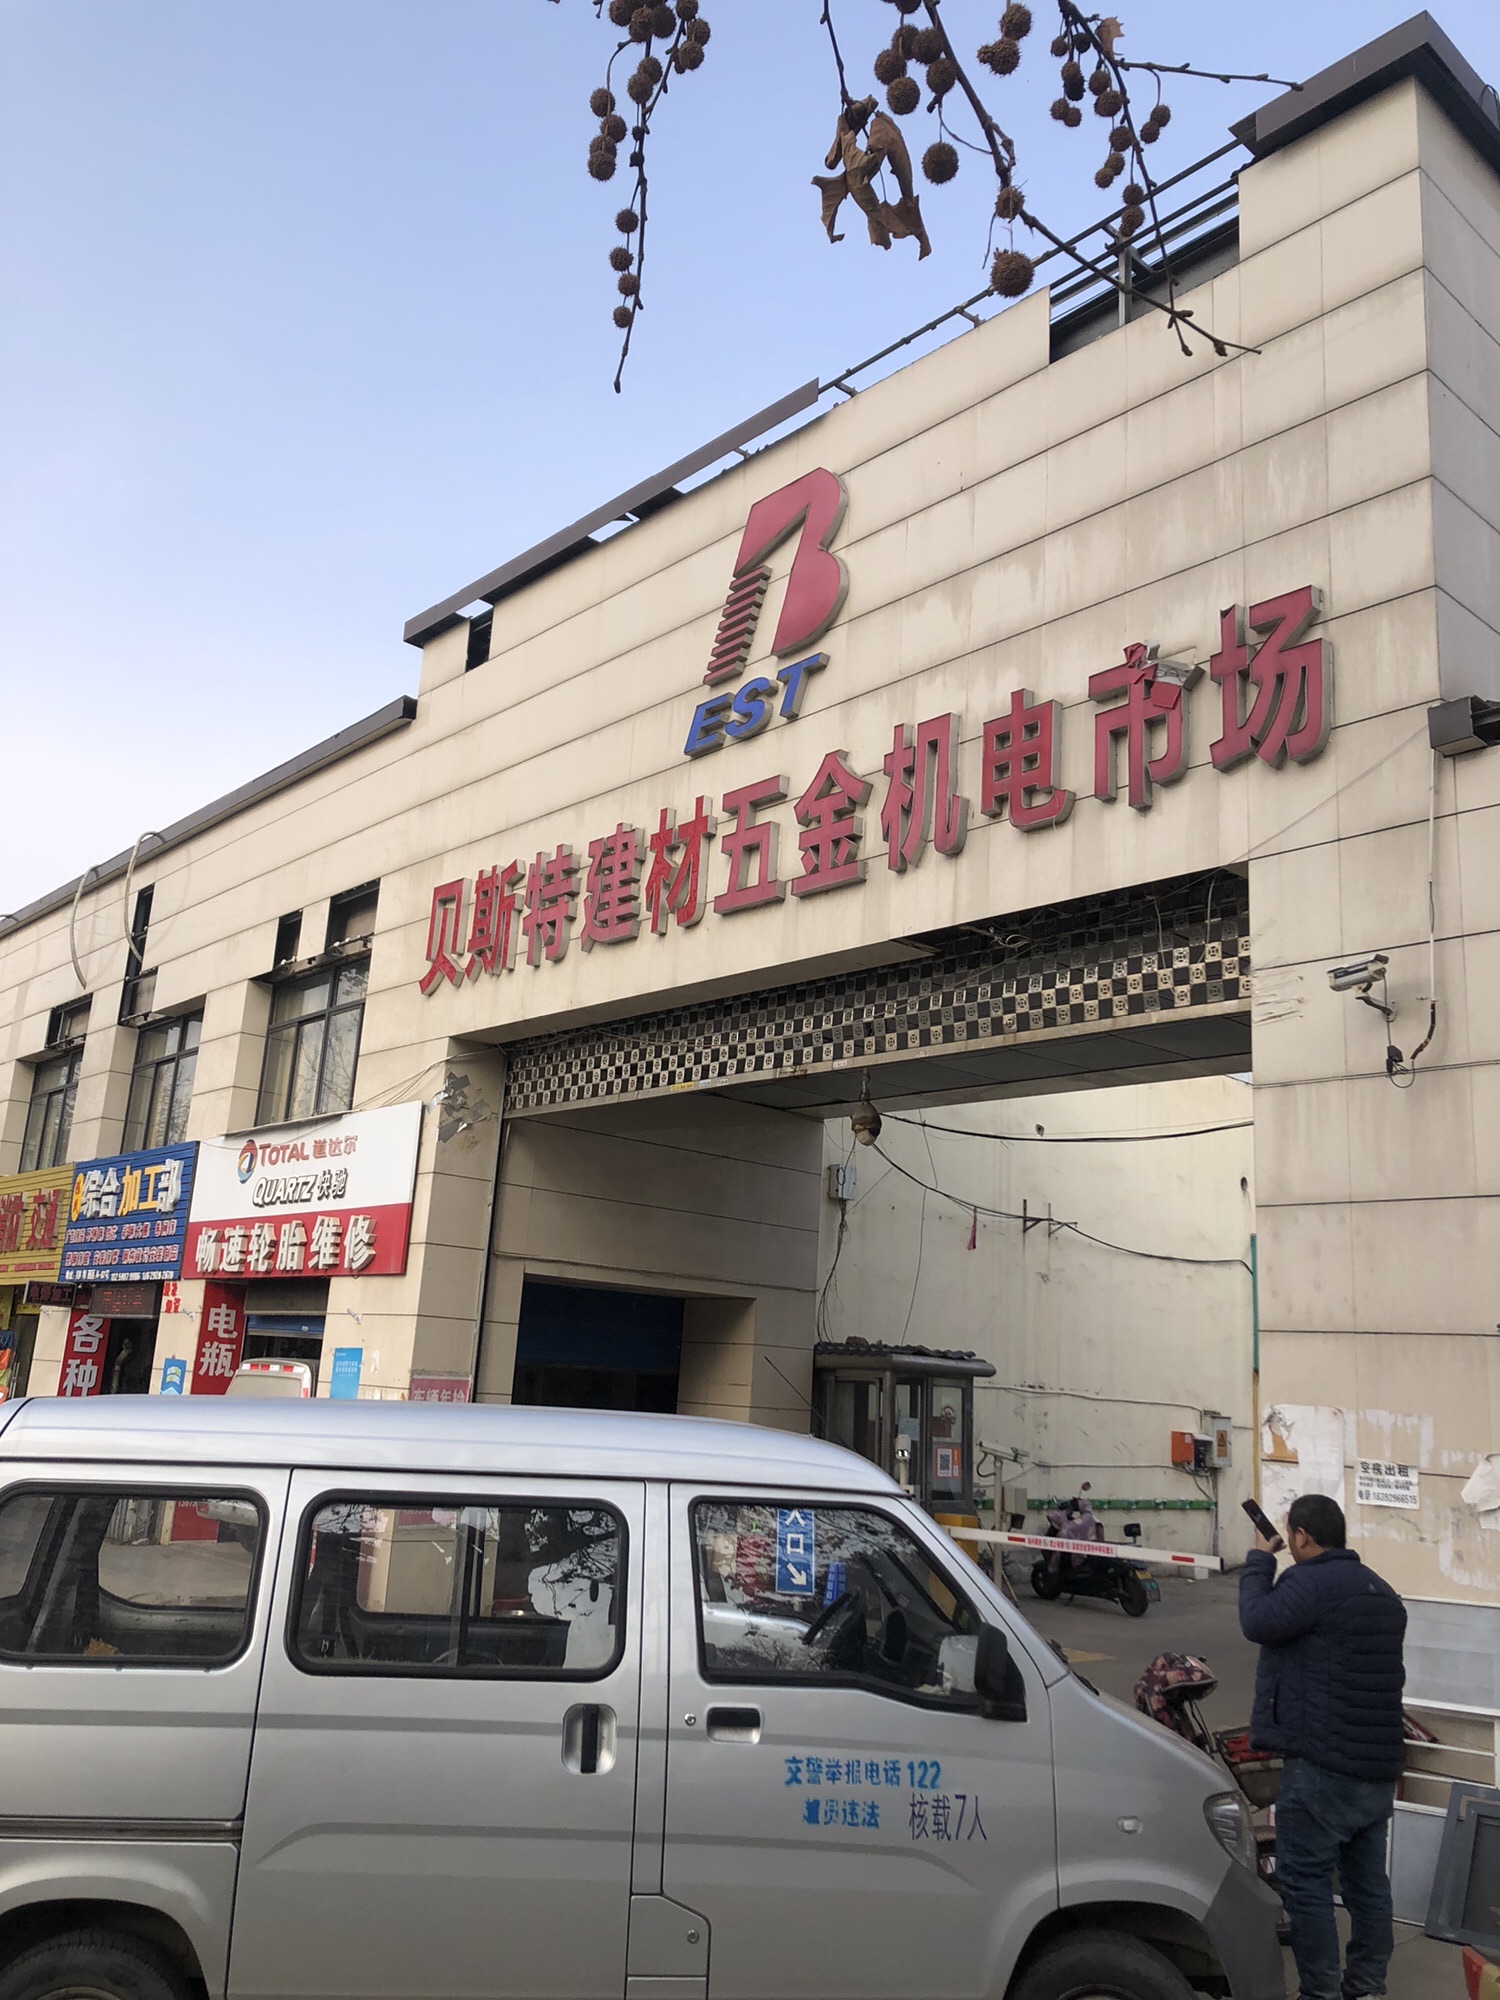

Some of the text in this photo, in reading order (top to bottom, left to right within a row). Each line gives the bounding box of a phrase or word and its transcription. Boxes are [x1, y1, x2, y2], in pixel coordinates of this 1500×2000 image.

[683, 652, 830, 758] EST
[419, 585, 1333, 996] 贝斯特建材五金机电市场
[259, 1135, 358, 1166] TOTAL 道达尔
[81, 1158, 184, 1219] 综合加工部
[252, 1174, 318, 1207] QUARTZ
[196, 1214, 376, 1274] 畅速轮胎维修
[63, 1315, 103, 1396] 各种
[199, 1303, 238, 1377] 电瓶
[1360, 1461, 1410, 1477] 空房出租
[784, 1755, 942, 1789] 交警举报电话 122
[909, 1793, 988, 1841] 核载7人
